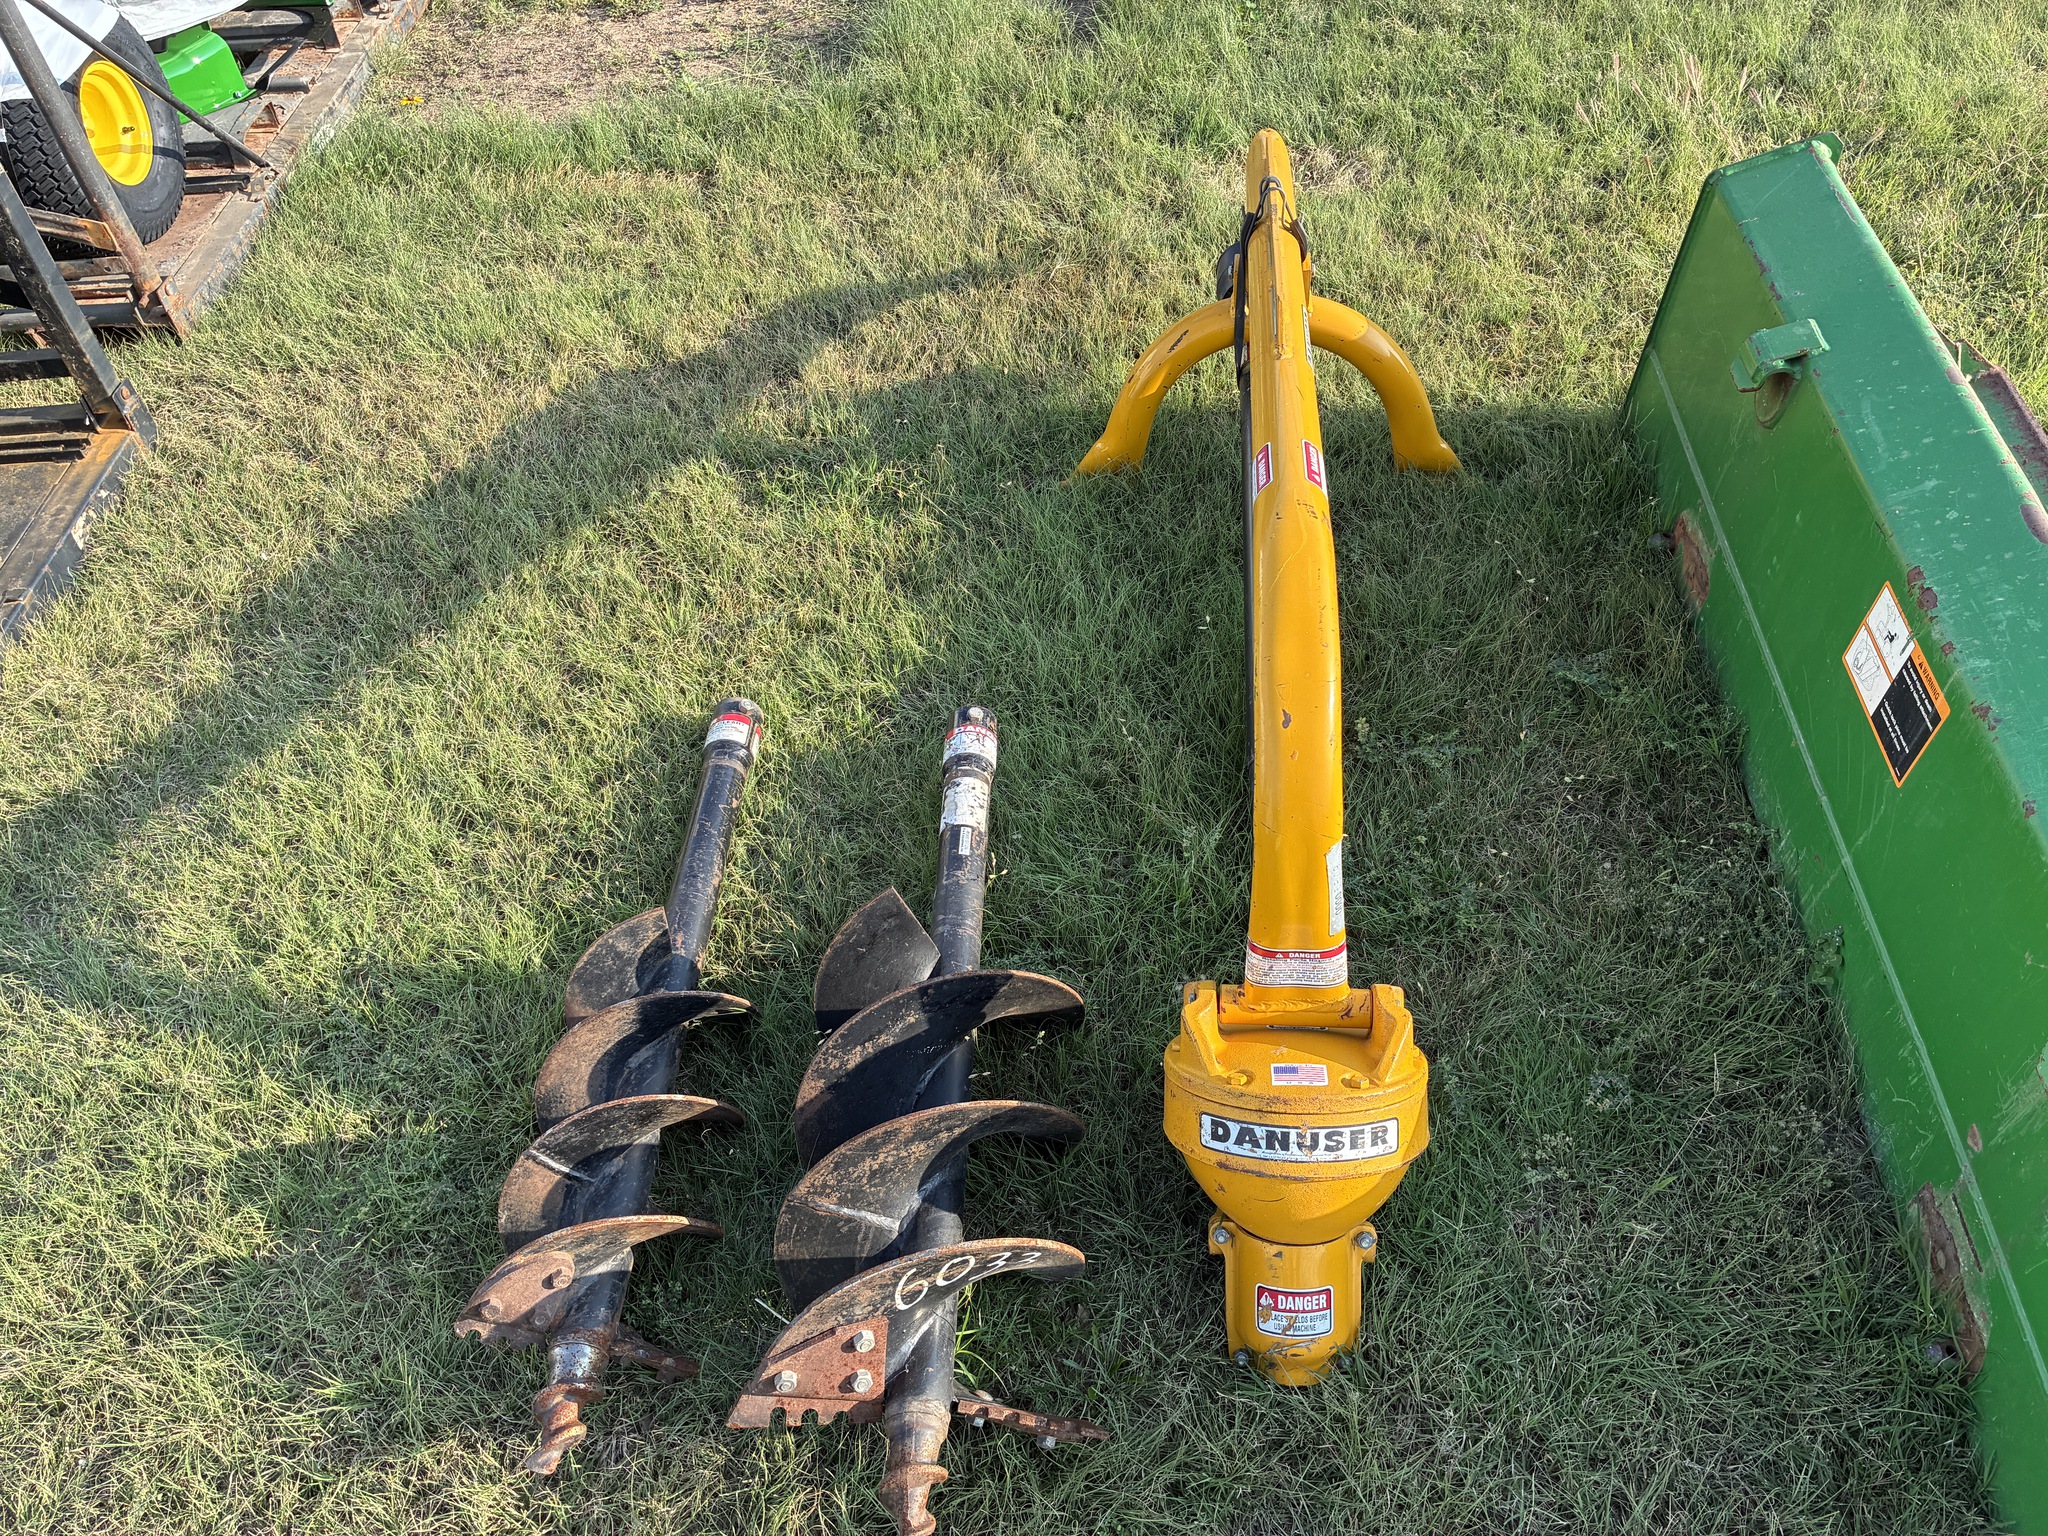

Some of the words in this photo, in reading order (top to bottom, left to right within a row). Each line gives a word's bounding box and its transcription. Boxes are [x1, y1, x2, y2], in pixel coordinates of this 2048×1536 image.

[1922, 666, 1940, 701] WARNING
[1210, 1118, 1389, 1153] DANUSER
[895, 1252, 1042, 1311] 6033
[1277, 1294, 1327, 1311] DANGER
[1309, 1313, 1328, 1324] BEFORE
